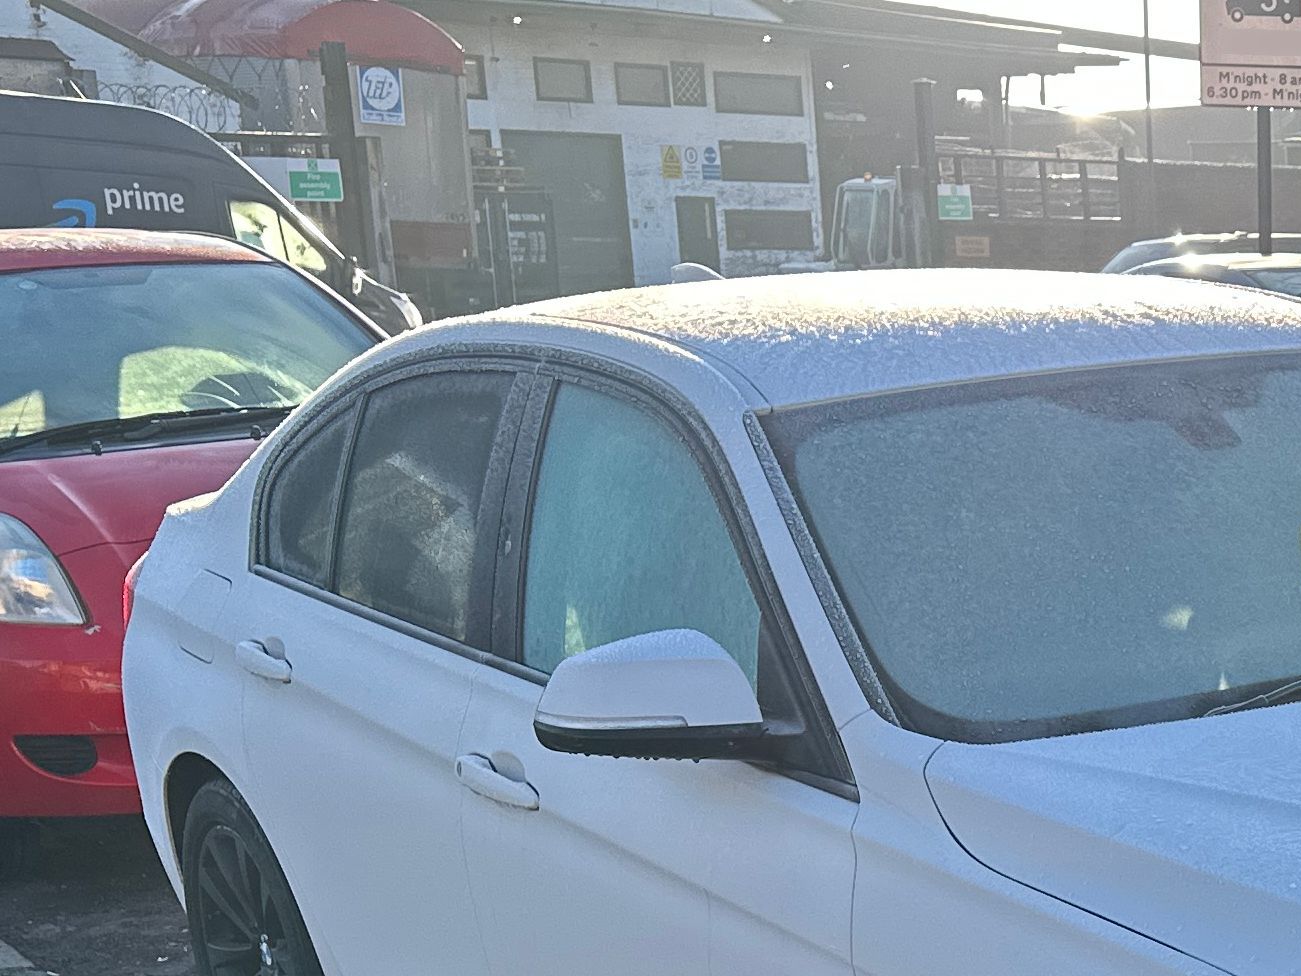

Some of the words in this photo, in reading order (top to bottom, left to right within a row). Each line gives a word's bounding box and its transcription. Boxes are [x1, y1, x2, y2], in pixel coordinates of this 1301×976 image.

[1218, 71, 1268, 86] M'night
[1279, 73, 1287, 85] 8
[1241, 89, 1261, 101] pm
[103, 182, 185, 215] prime
